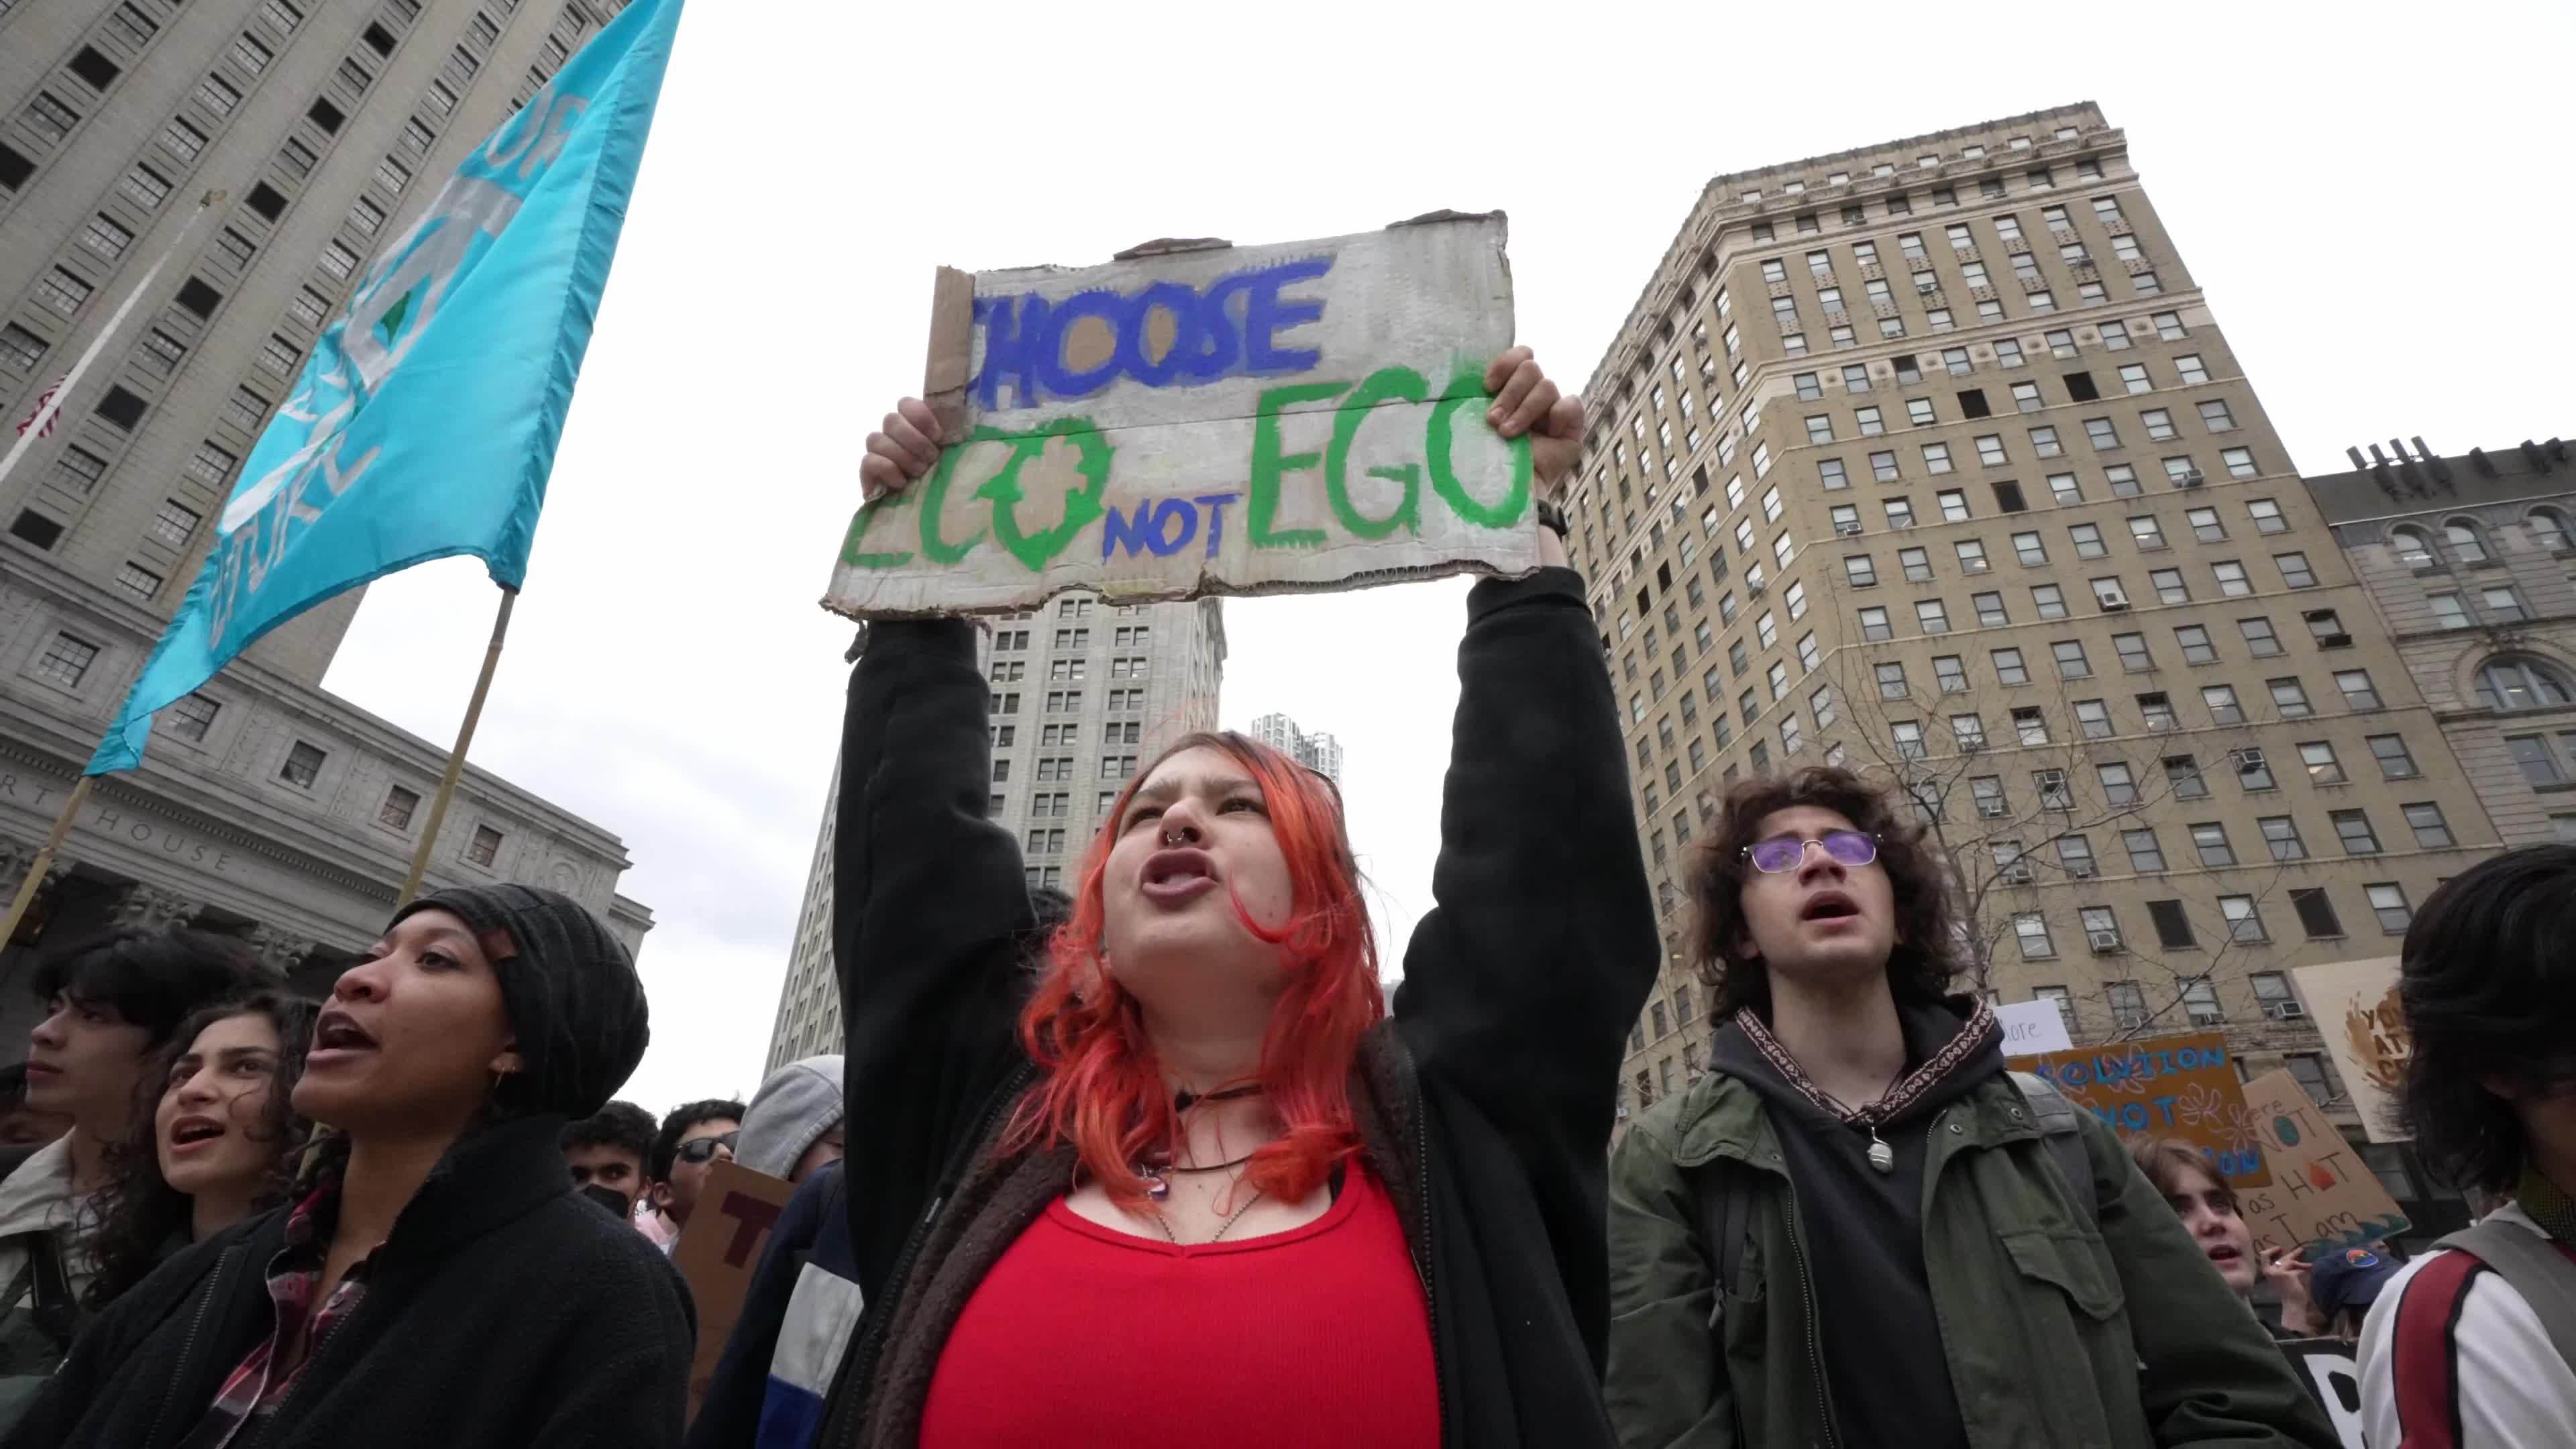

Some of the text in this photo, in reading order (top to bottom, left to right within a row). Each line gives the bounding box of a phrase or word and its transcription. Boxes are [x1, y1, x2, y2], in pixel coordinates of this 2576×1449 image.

[1102, 494, 1245, 565] NOT
[1248, 366, 1534, 549] EGO
[97, 810, 232, 871] HOUSE
[2092, 1095, 2178, 1131] NOT
[2202, 1148, 2260, 1176] ON
[2249, 1193, 2275, 1214] as
[2316, 1211, 2362, 1238] am
